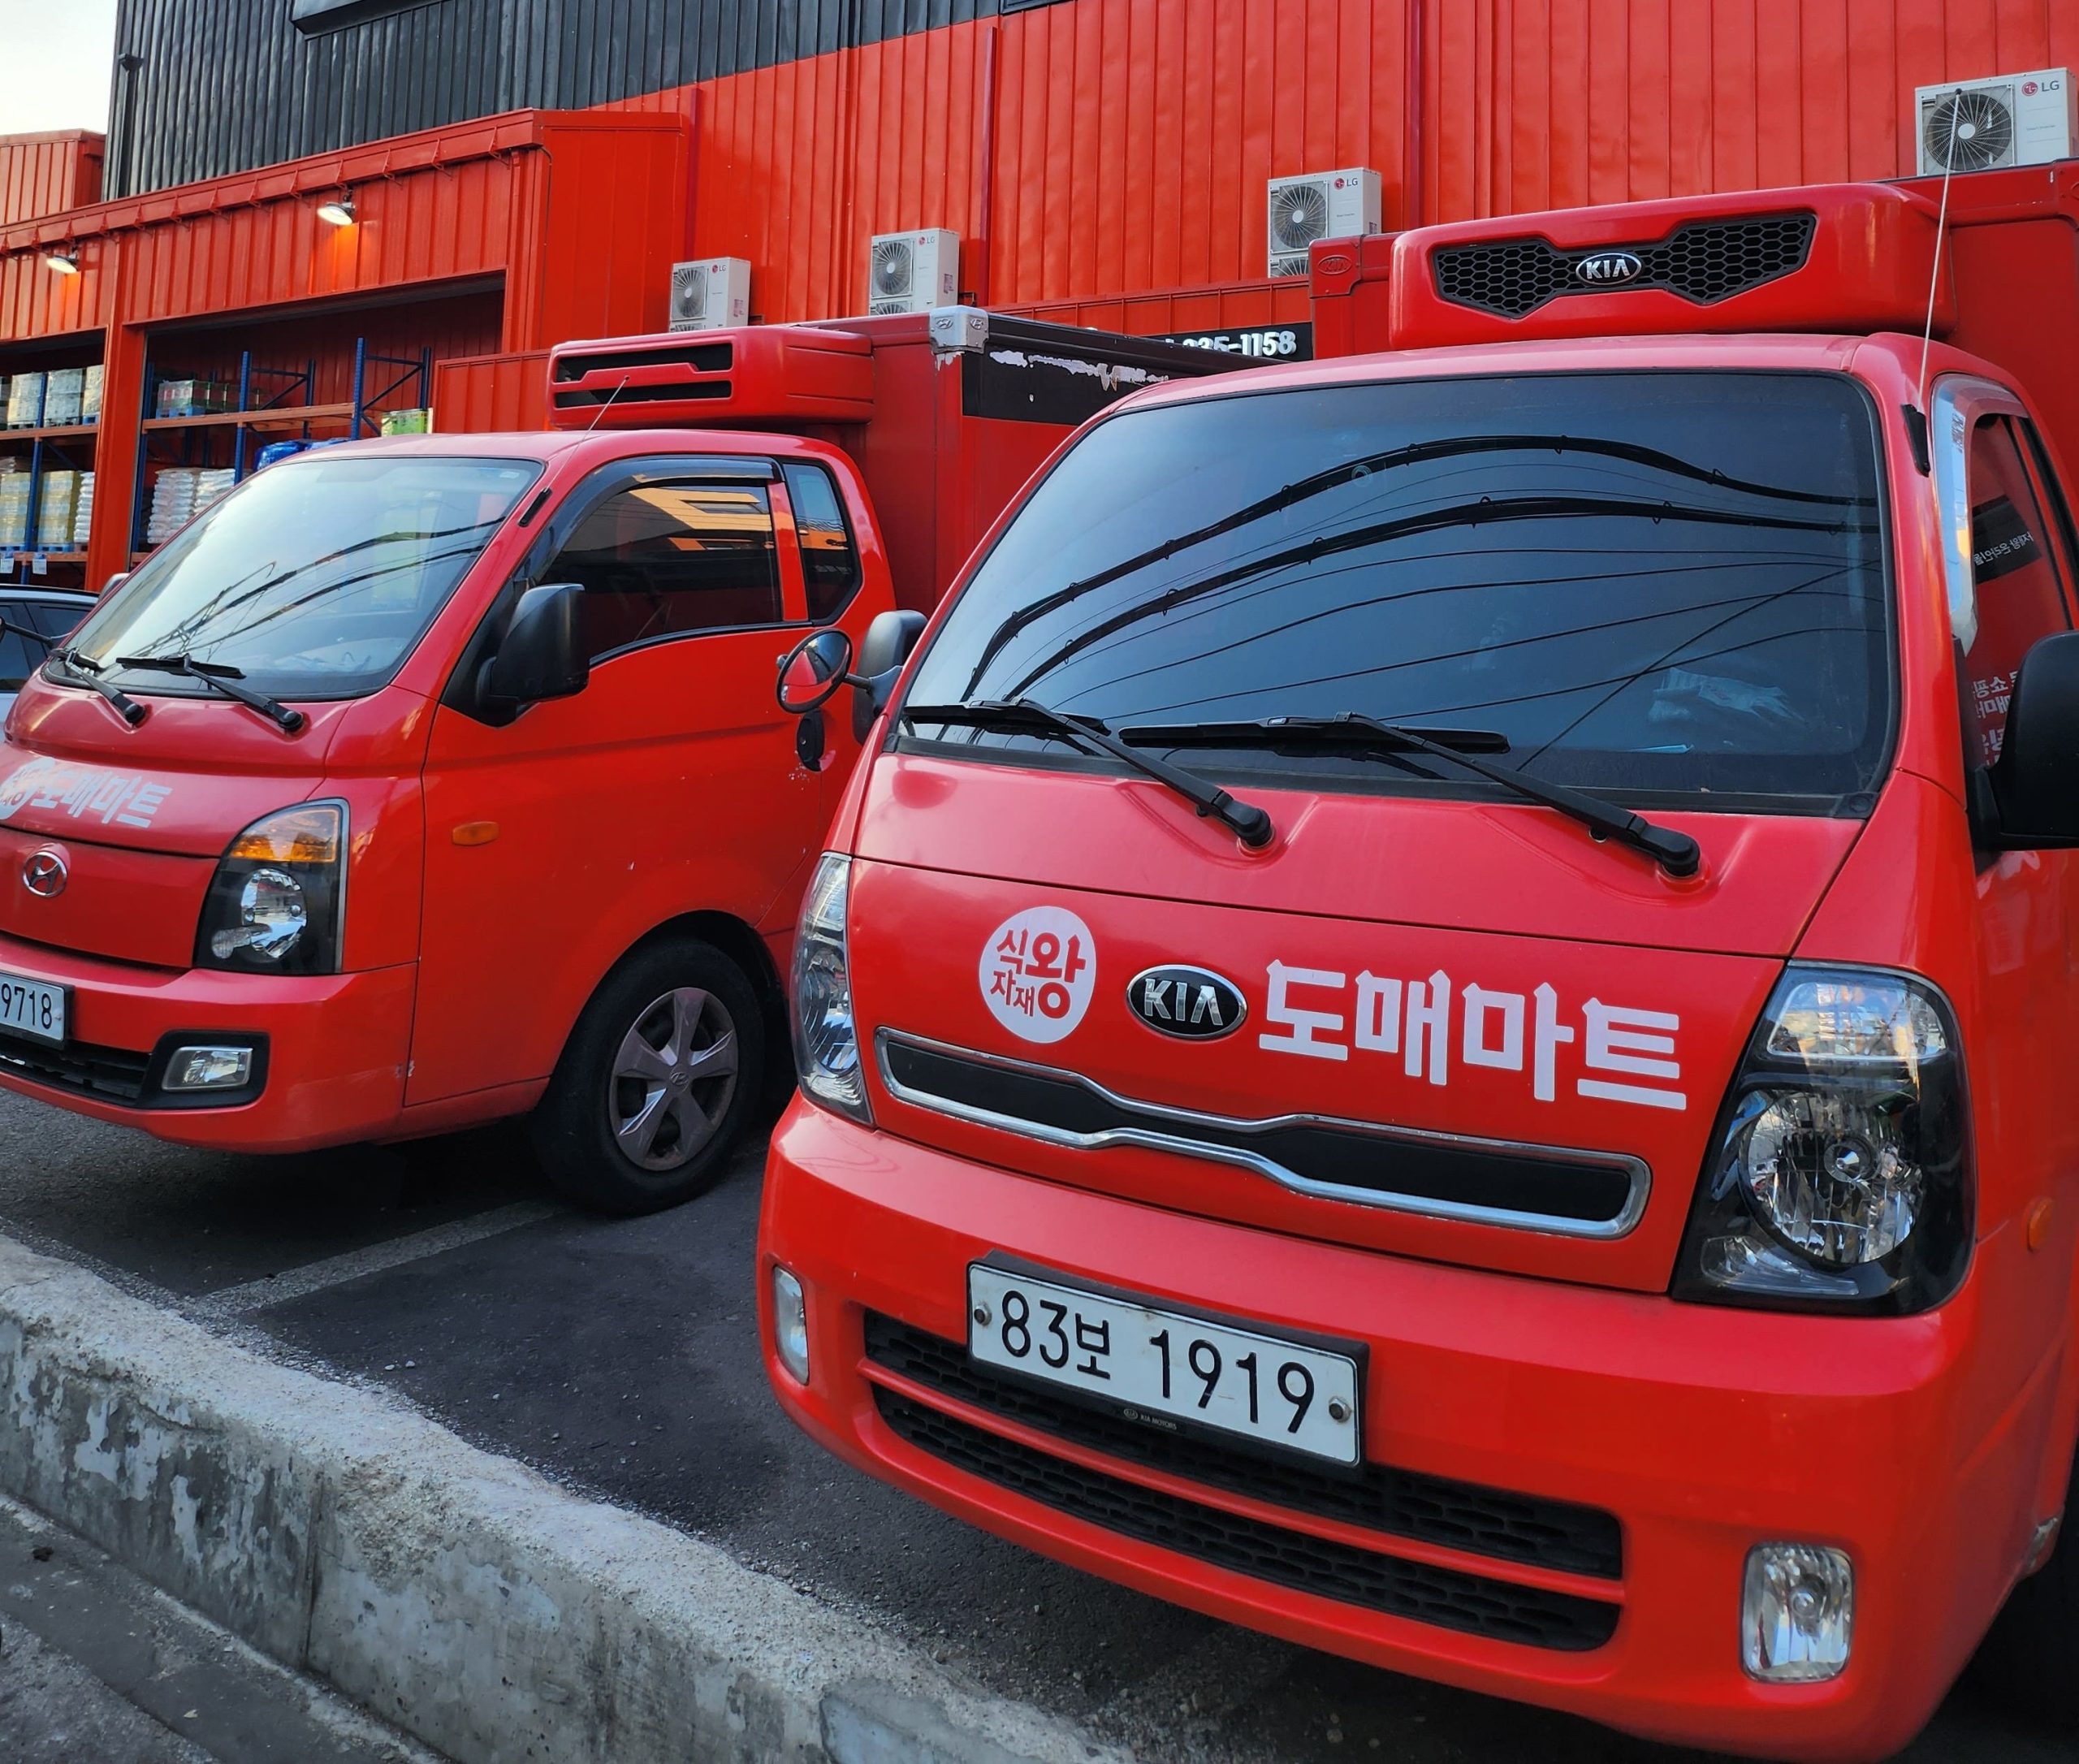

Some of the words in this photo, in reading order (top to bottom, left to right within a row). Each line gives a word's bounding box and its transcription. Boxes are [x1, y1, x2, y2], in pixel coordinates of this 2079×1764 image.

[2041, 80, 2060, 93] LG
[1346, 177, 1359, 188] LG
[927, 236, 936, 244] LG
[1586, 258, 1631, 279] KIA
[1, 982, 53, 1030] 9718
[1143, 977, 1224, 1027] KIA
[1259, 958, 1687, 1111] 도매마트
[1001, 1289, 1111, 1381] 83보
[1148, 1328, 1316, 1434] 1919
[1152, 1416, 1178, 1430] MOTORS
